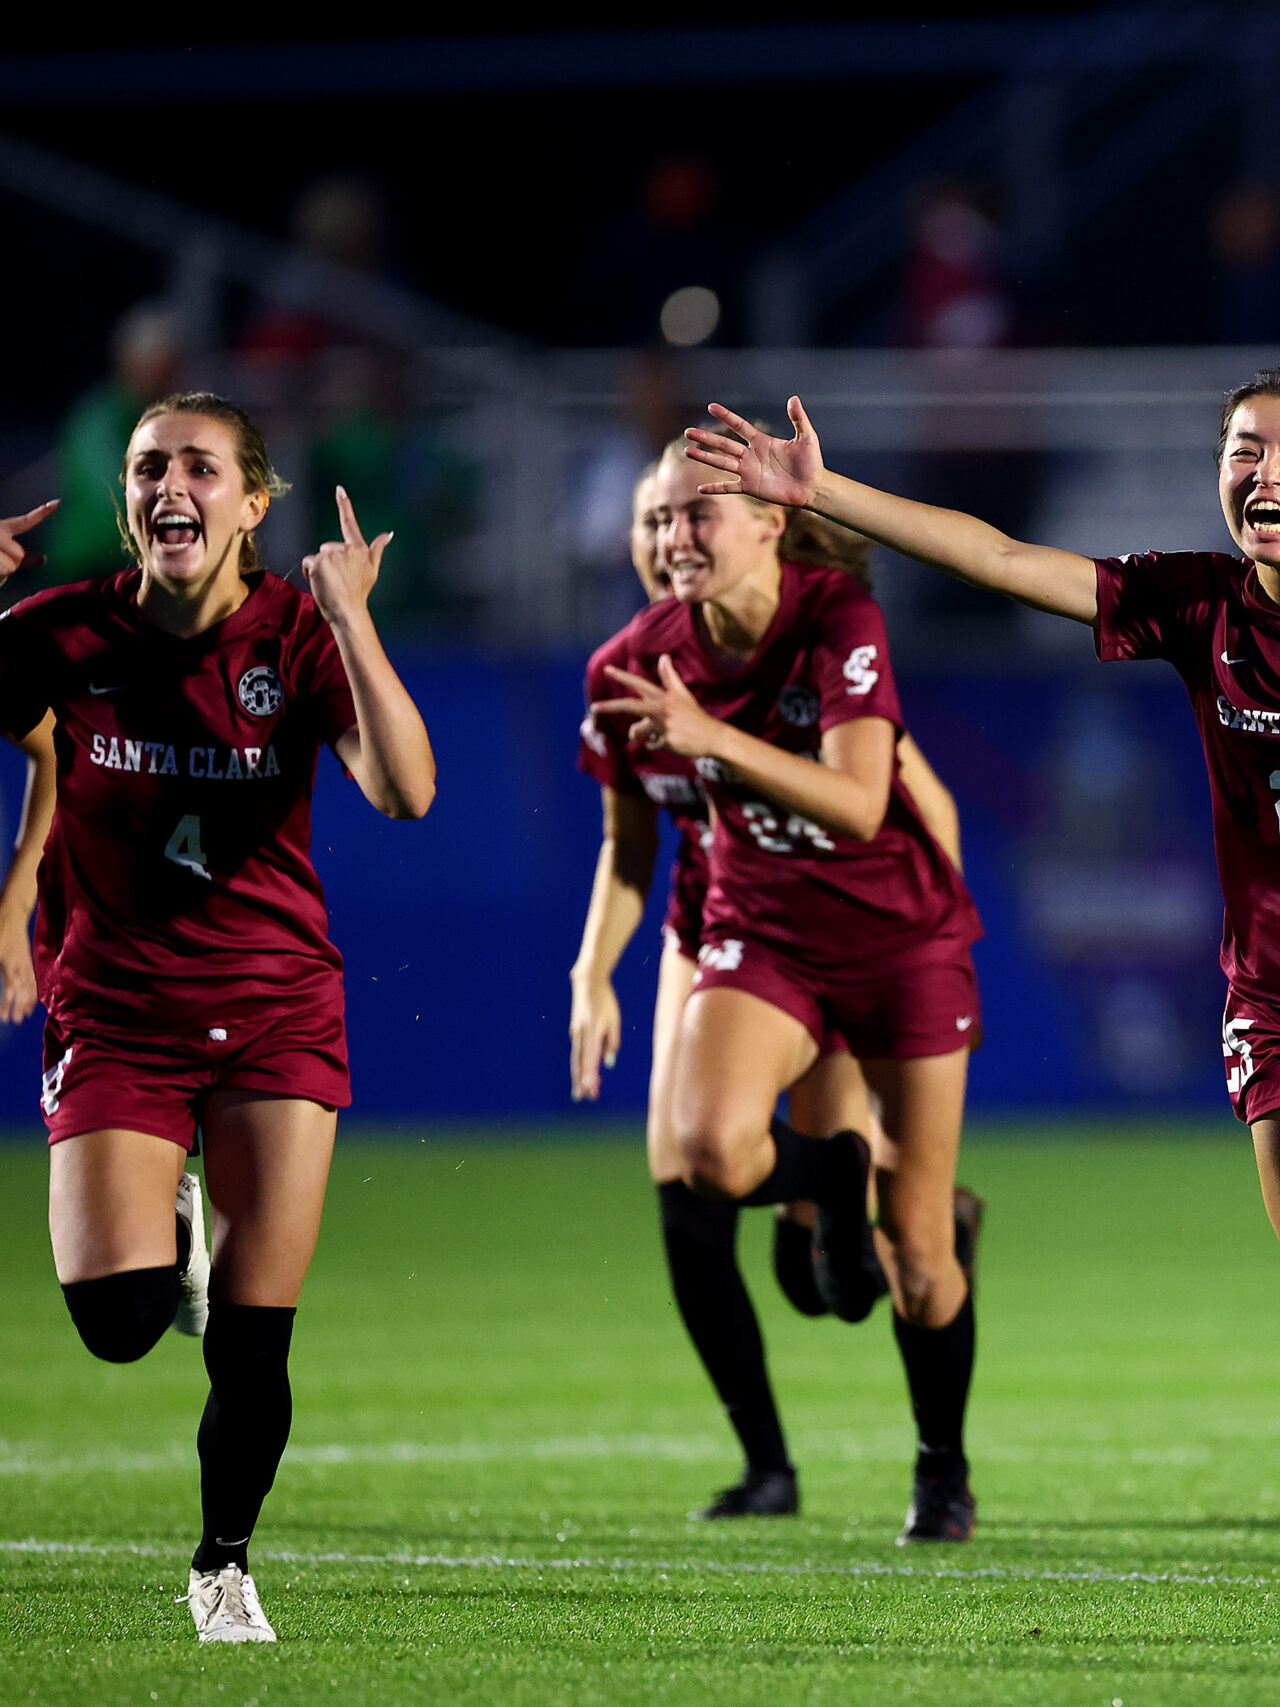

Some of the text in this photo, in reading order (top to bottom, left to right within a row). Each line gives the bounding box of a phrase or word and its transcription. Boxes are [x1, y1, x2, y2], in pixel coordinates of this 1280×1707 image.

[89, 733, 281, 780] SANTA CLARA
[163, 814, 213, 882] 4
